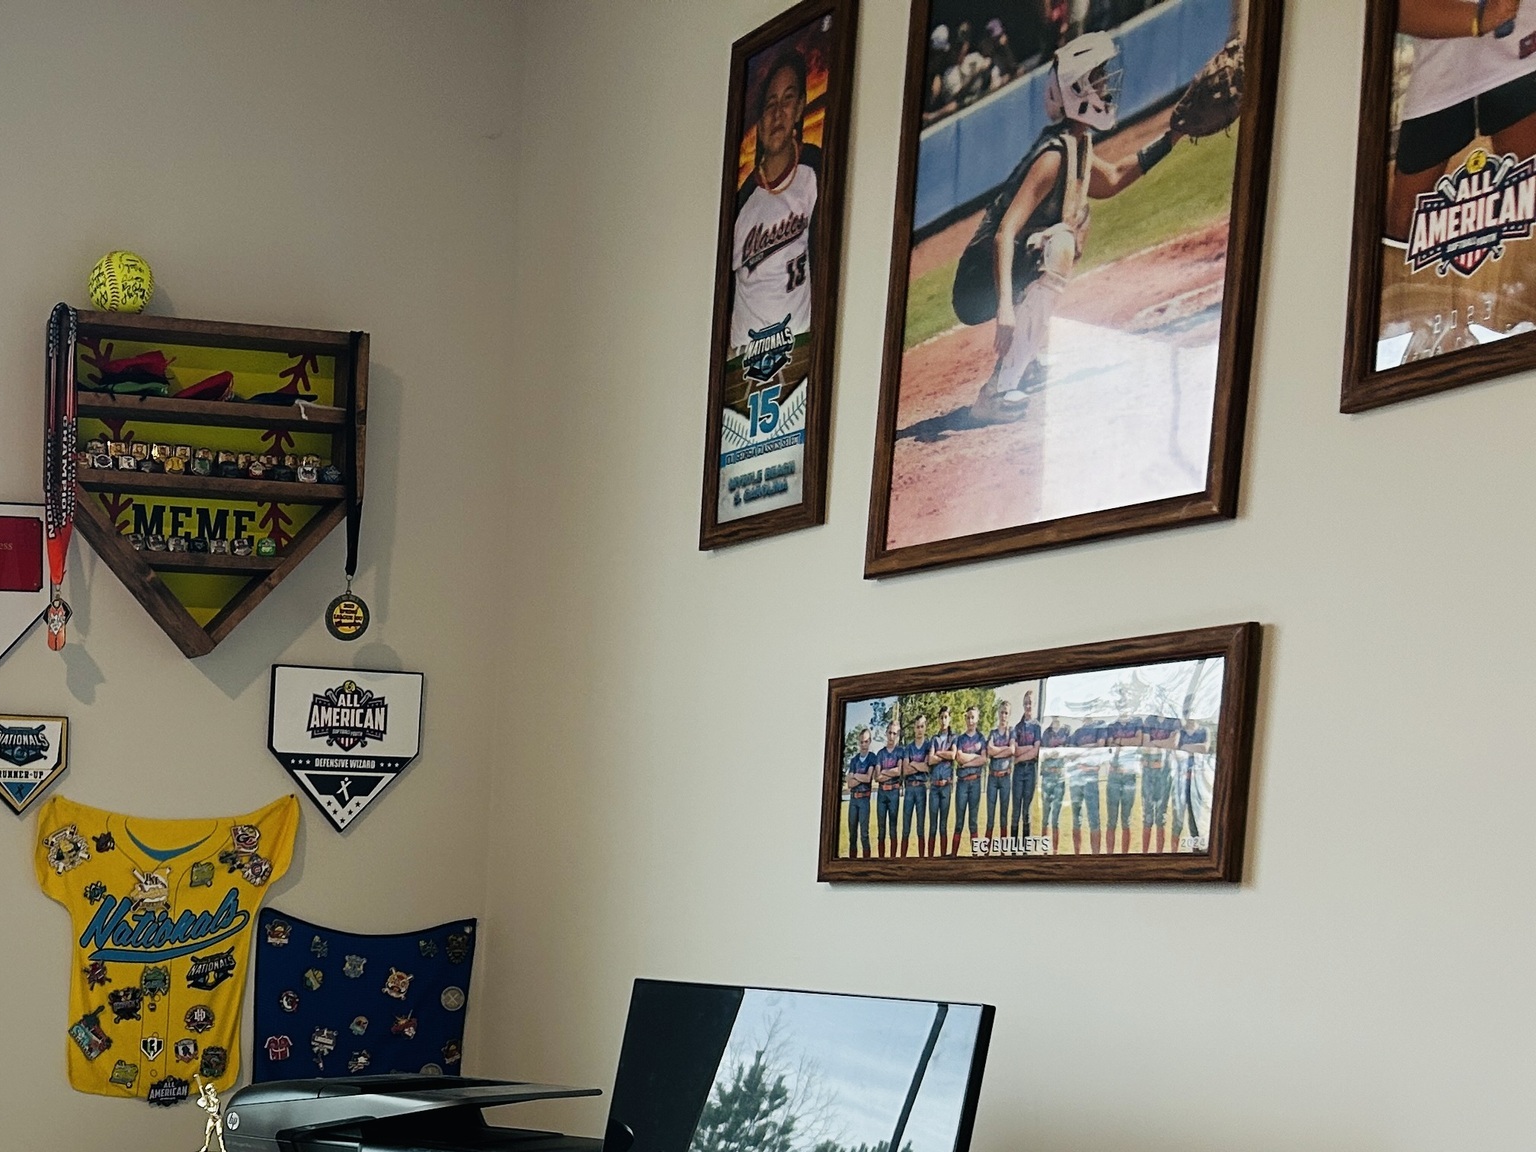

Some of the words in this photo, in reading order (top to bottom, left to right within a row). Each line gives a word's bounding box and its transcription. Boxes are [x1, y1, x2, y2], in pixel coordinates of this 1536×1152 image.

[1455, 170, 1495, 203] ALL
[1411, 174, 1536, 257] AMERICAN
[746, 327, 794, 359] NATIONALS
[748, 384, 782, 438] 15
[132, 503, 256, 550] MEME
[337, 693, 361, 707] ALL
[309, 704, 386, 732] AMERICAN
[314, 757, 349, 768] DEFENSIVE
[349, 759, 376, 769] WIZARD
[971, 837, 989, 854] EC
[991, 836, 1051, 854] BULLETS
[79, 887, 244, 949] Nationals
[188, 955, 237, 978] NATIONALS
[149, 1085, 188, 1100] AMERICAN
